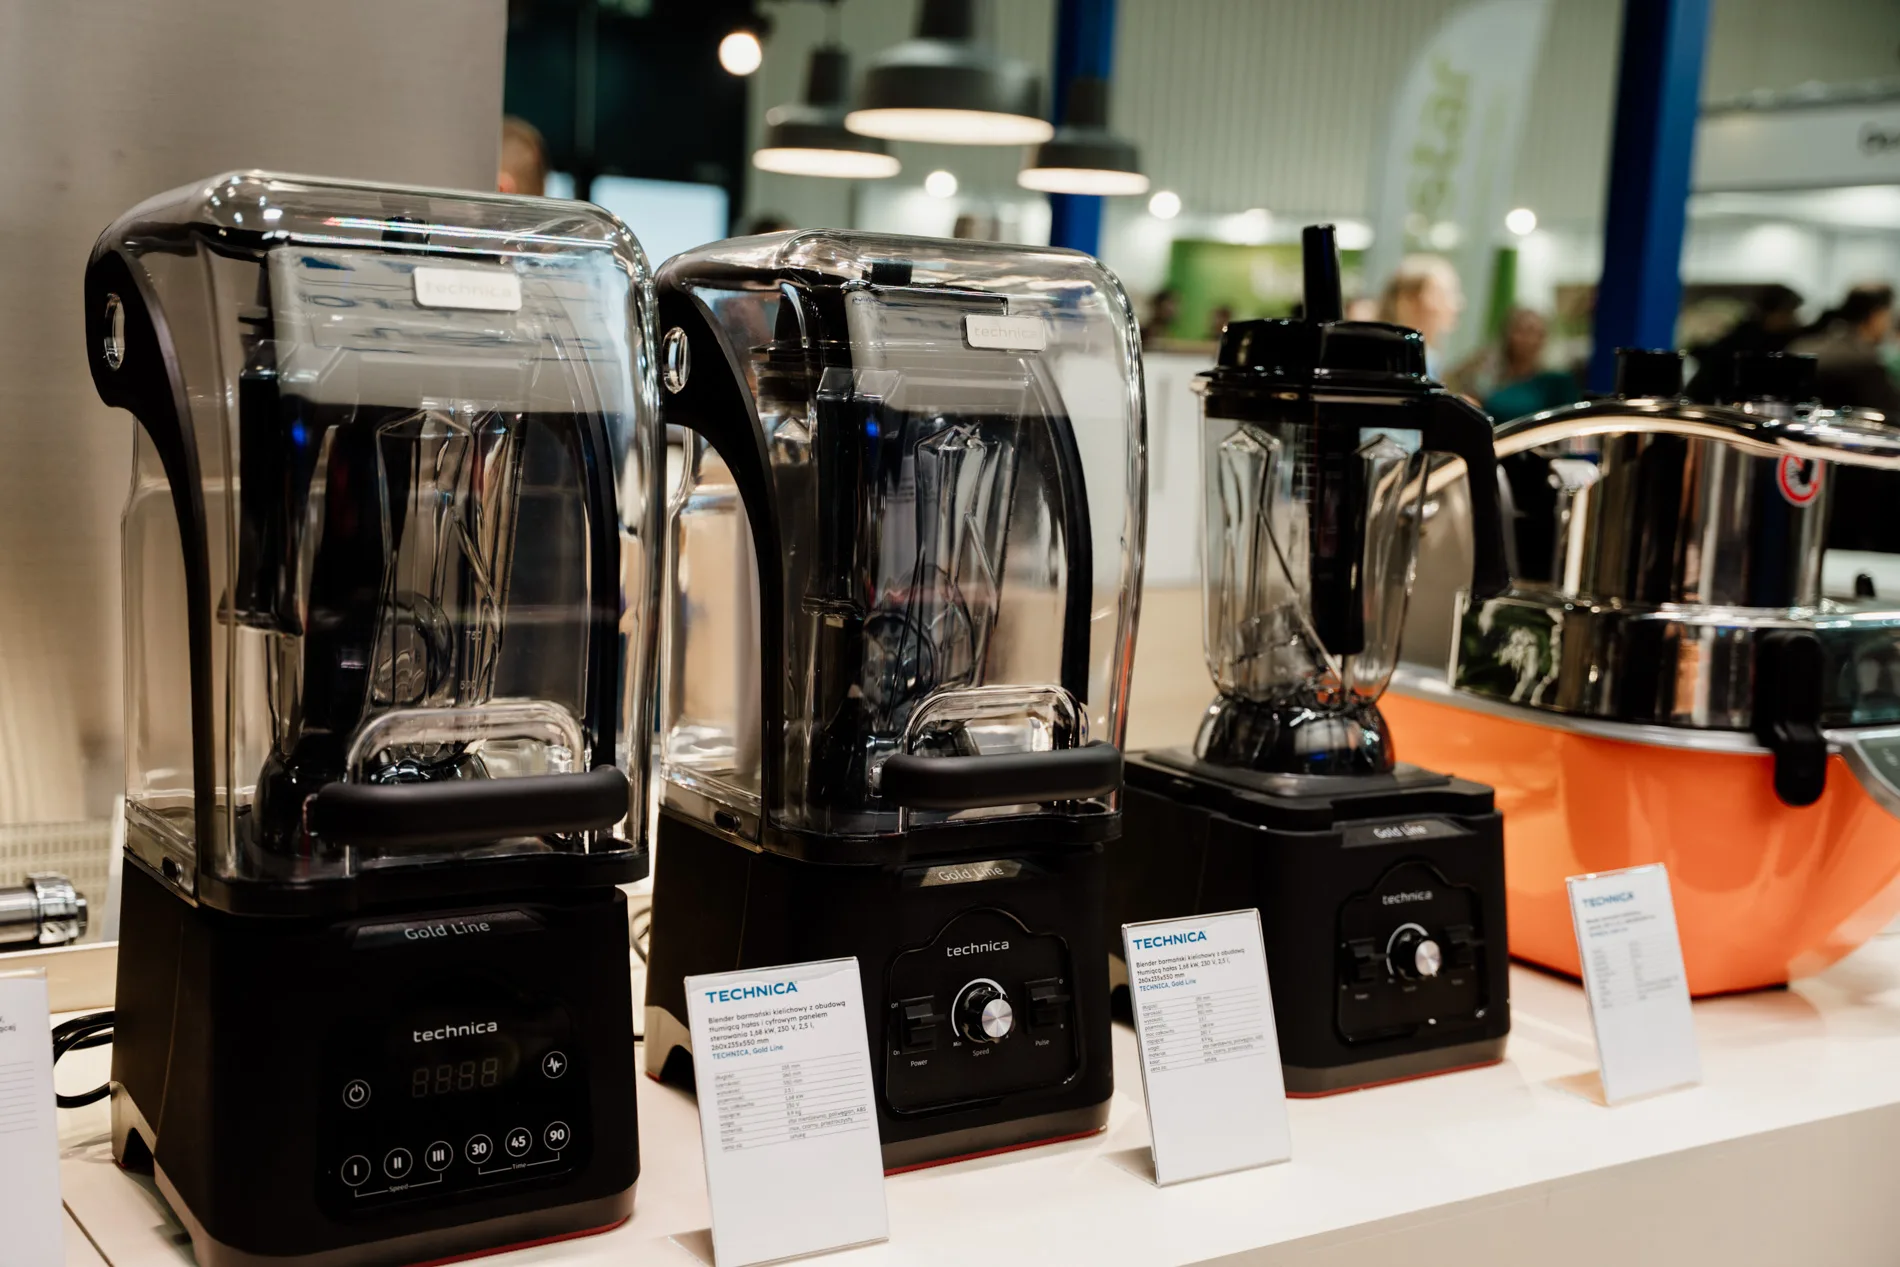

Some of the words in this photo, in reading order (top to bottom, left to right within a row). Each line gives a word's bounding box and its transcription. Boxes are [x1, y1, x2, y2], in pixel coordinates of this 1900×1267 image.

[974, 326, 1038, 340] technica
[1373, 826, 1403, 839] Gold
[1400, 824, 1427, 836] Line
[938, 869, 972, 881] Gold
[973, 866, 1004, 878] Line
[1382, 890, 1433, 905] technica
[404, 924, 448, 940] Gold
[451, 921, 491, 935] Line
[1133, 931, 1206, 950] TECHNICA
[946, 940, 1010, 957] technica
[1136, 960, 1157, 968] Blender
[705, 981, 798, 1003] TECHNICA
[1139, 982, 1170, 992] TECHNICA,
[1171, 979, 1184, 987] Gold
[708, 1015, 734, 1024] Blender
[736, 1010, 771, 1021] barmański
[772, 1005, 808, 1016] kielichowy
[814, 1001, 846, 1010] obudową
[741, 1019, 760, 1029] hałas
[764, 1015, 797, 1027] cyfrowym
[799, 1012, 828, 1022] panelem
[413, 1021, 498, 1042] technica
[710, 1032, 746, 1042] sterowania
[1035, 1039, 1050, 1047] Pulse
[712, 1049, 752, 1060] TECHNICA,
[752, 1046, 768, 1055] Gold
[769, 1043, 784, 1052] Line
[973, 1048, 990, 1057] Speed
[910, 1059, 928, 1067] Power
[550, 1128, 565, 1141] 90
[471, 1142, 487, 1155] 30
[511, 1136, 526, 1148] 45
[389, 1183, 409, 1193] Speed
